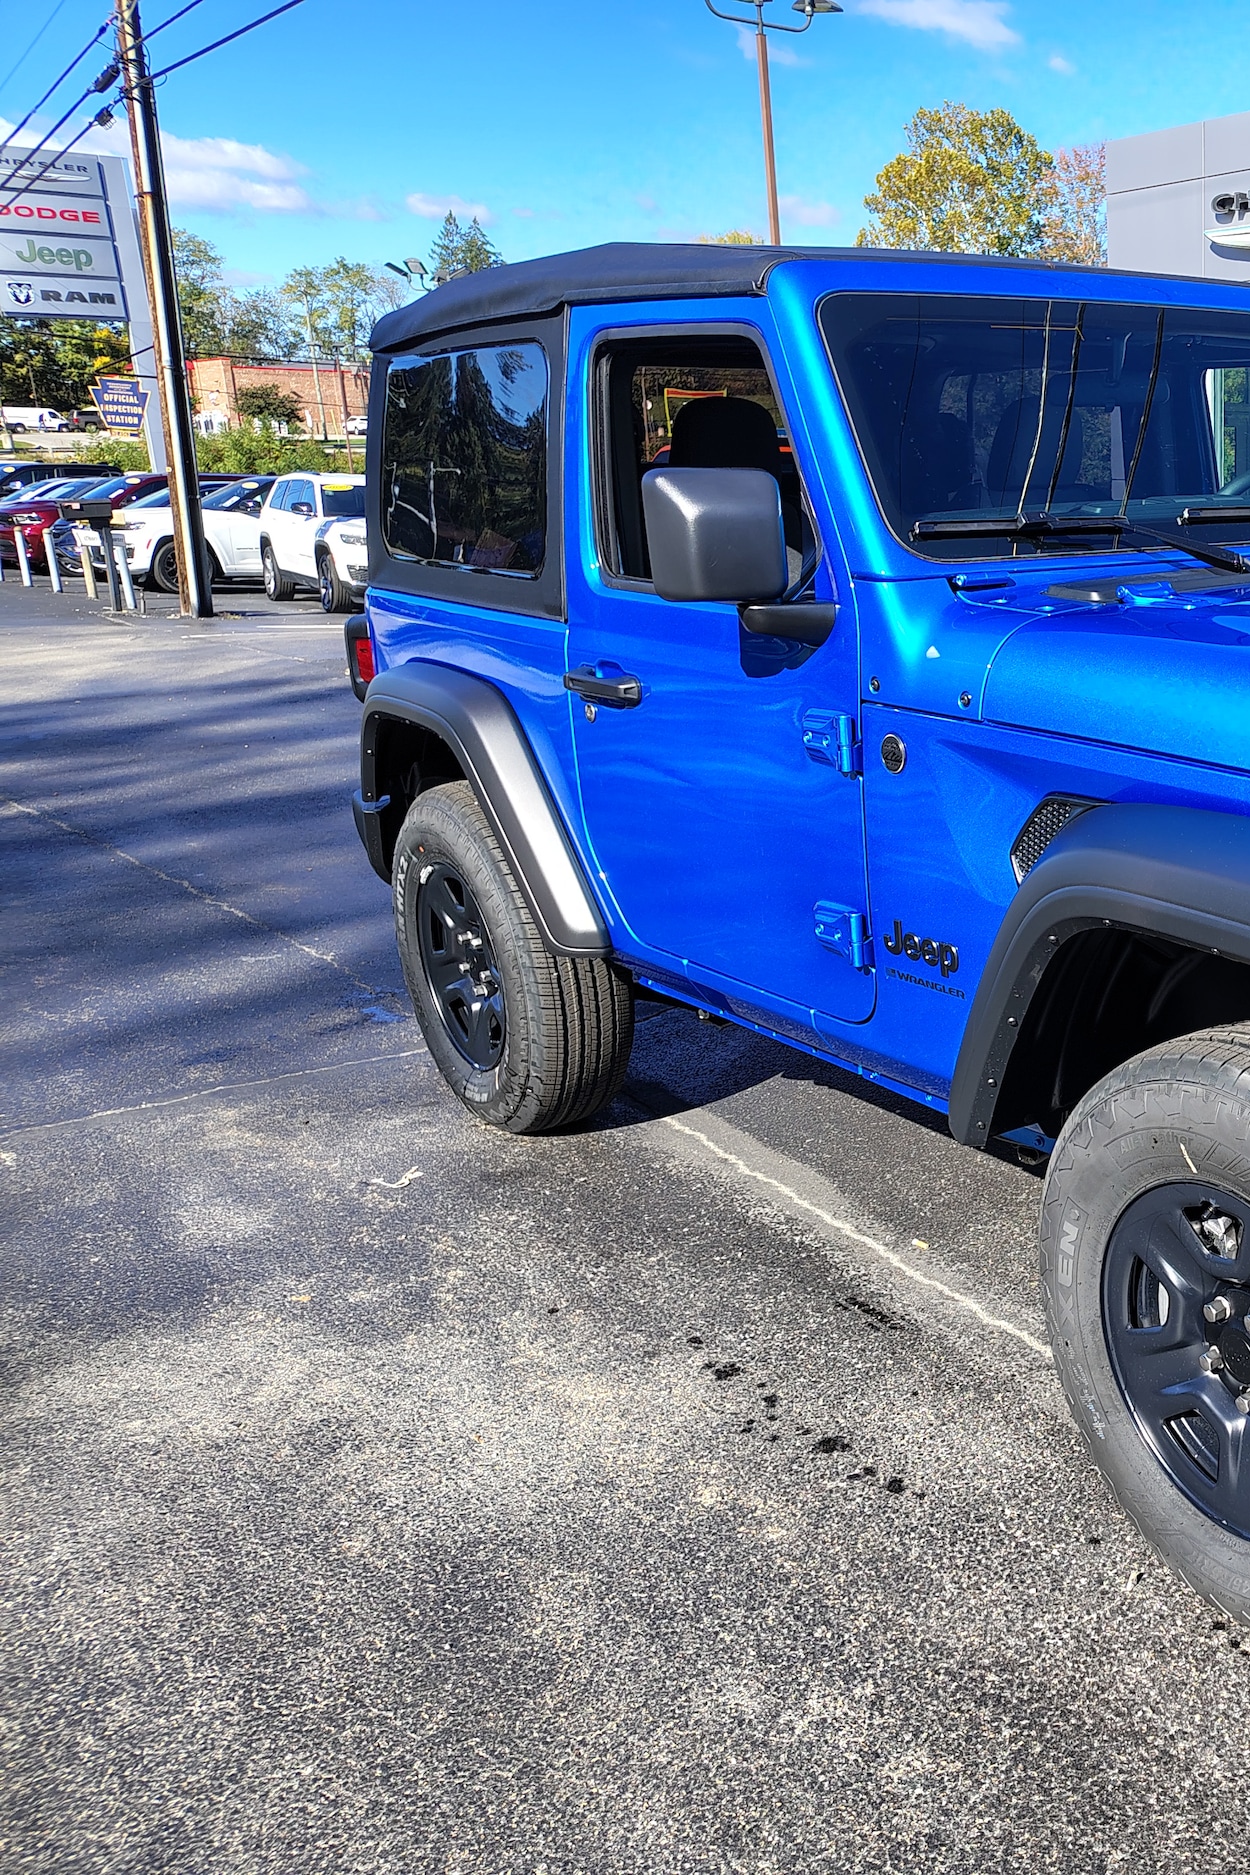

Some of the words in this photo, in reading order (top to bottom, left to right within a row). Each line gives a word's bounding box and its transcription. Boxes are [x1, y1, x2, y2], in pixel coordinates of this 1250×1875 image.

[0, 204, 101, 223] DODGE
[15, 239, 93, 271] Jeep
[40, 290, 116, 304] RAM
[103, 393, 139, 404] OFFICIAL
[100, 404, 142, 414] INSPECTION
[106, 415, 139, 424] STATION
[883, 919, 959, 979] Jeep
[897, 970, 966, 1000] WRANGLER
